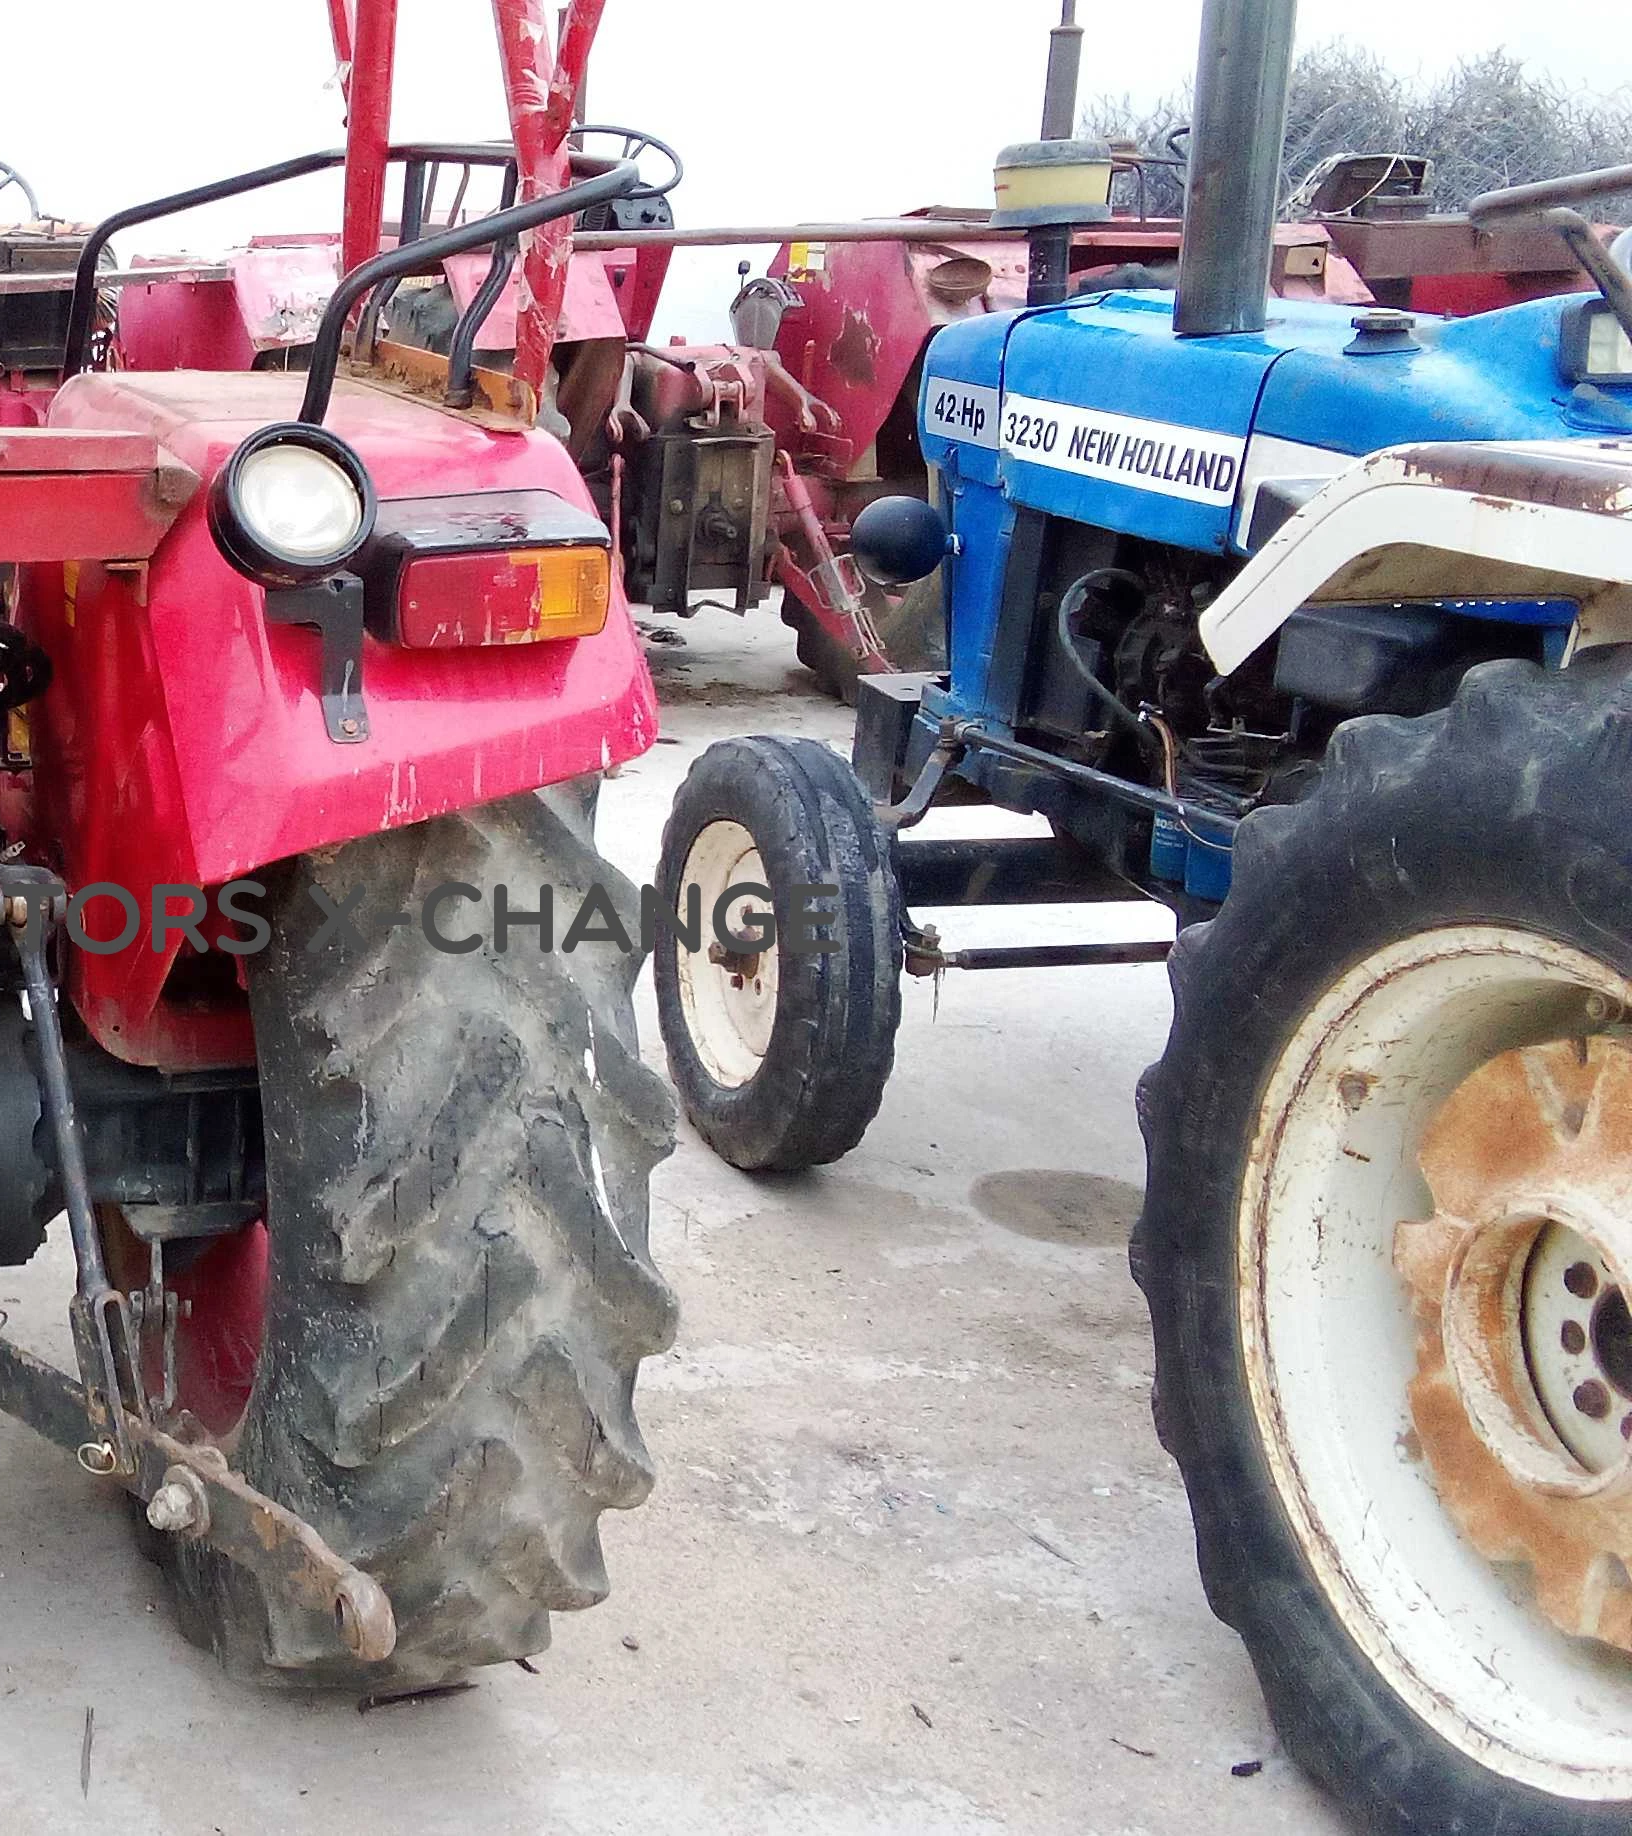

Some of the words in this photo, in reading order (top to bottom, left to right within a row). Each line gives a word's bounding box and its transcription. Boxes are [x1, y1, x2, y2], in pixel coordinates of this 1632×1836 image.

[934, 391, 985, 436] 42-Hp
[1005, 412, 1058, 453] 3230
[1067, 425, 1120, 468] NEW
[1118, 436, 1236, 492] HOLLAND
